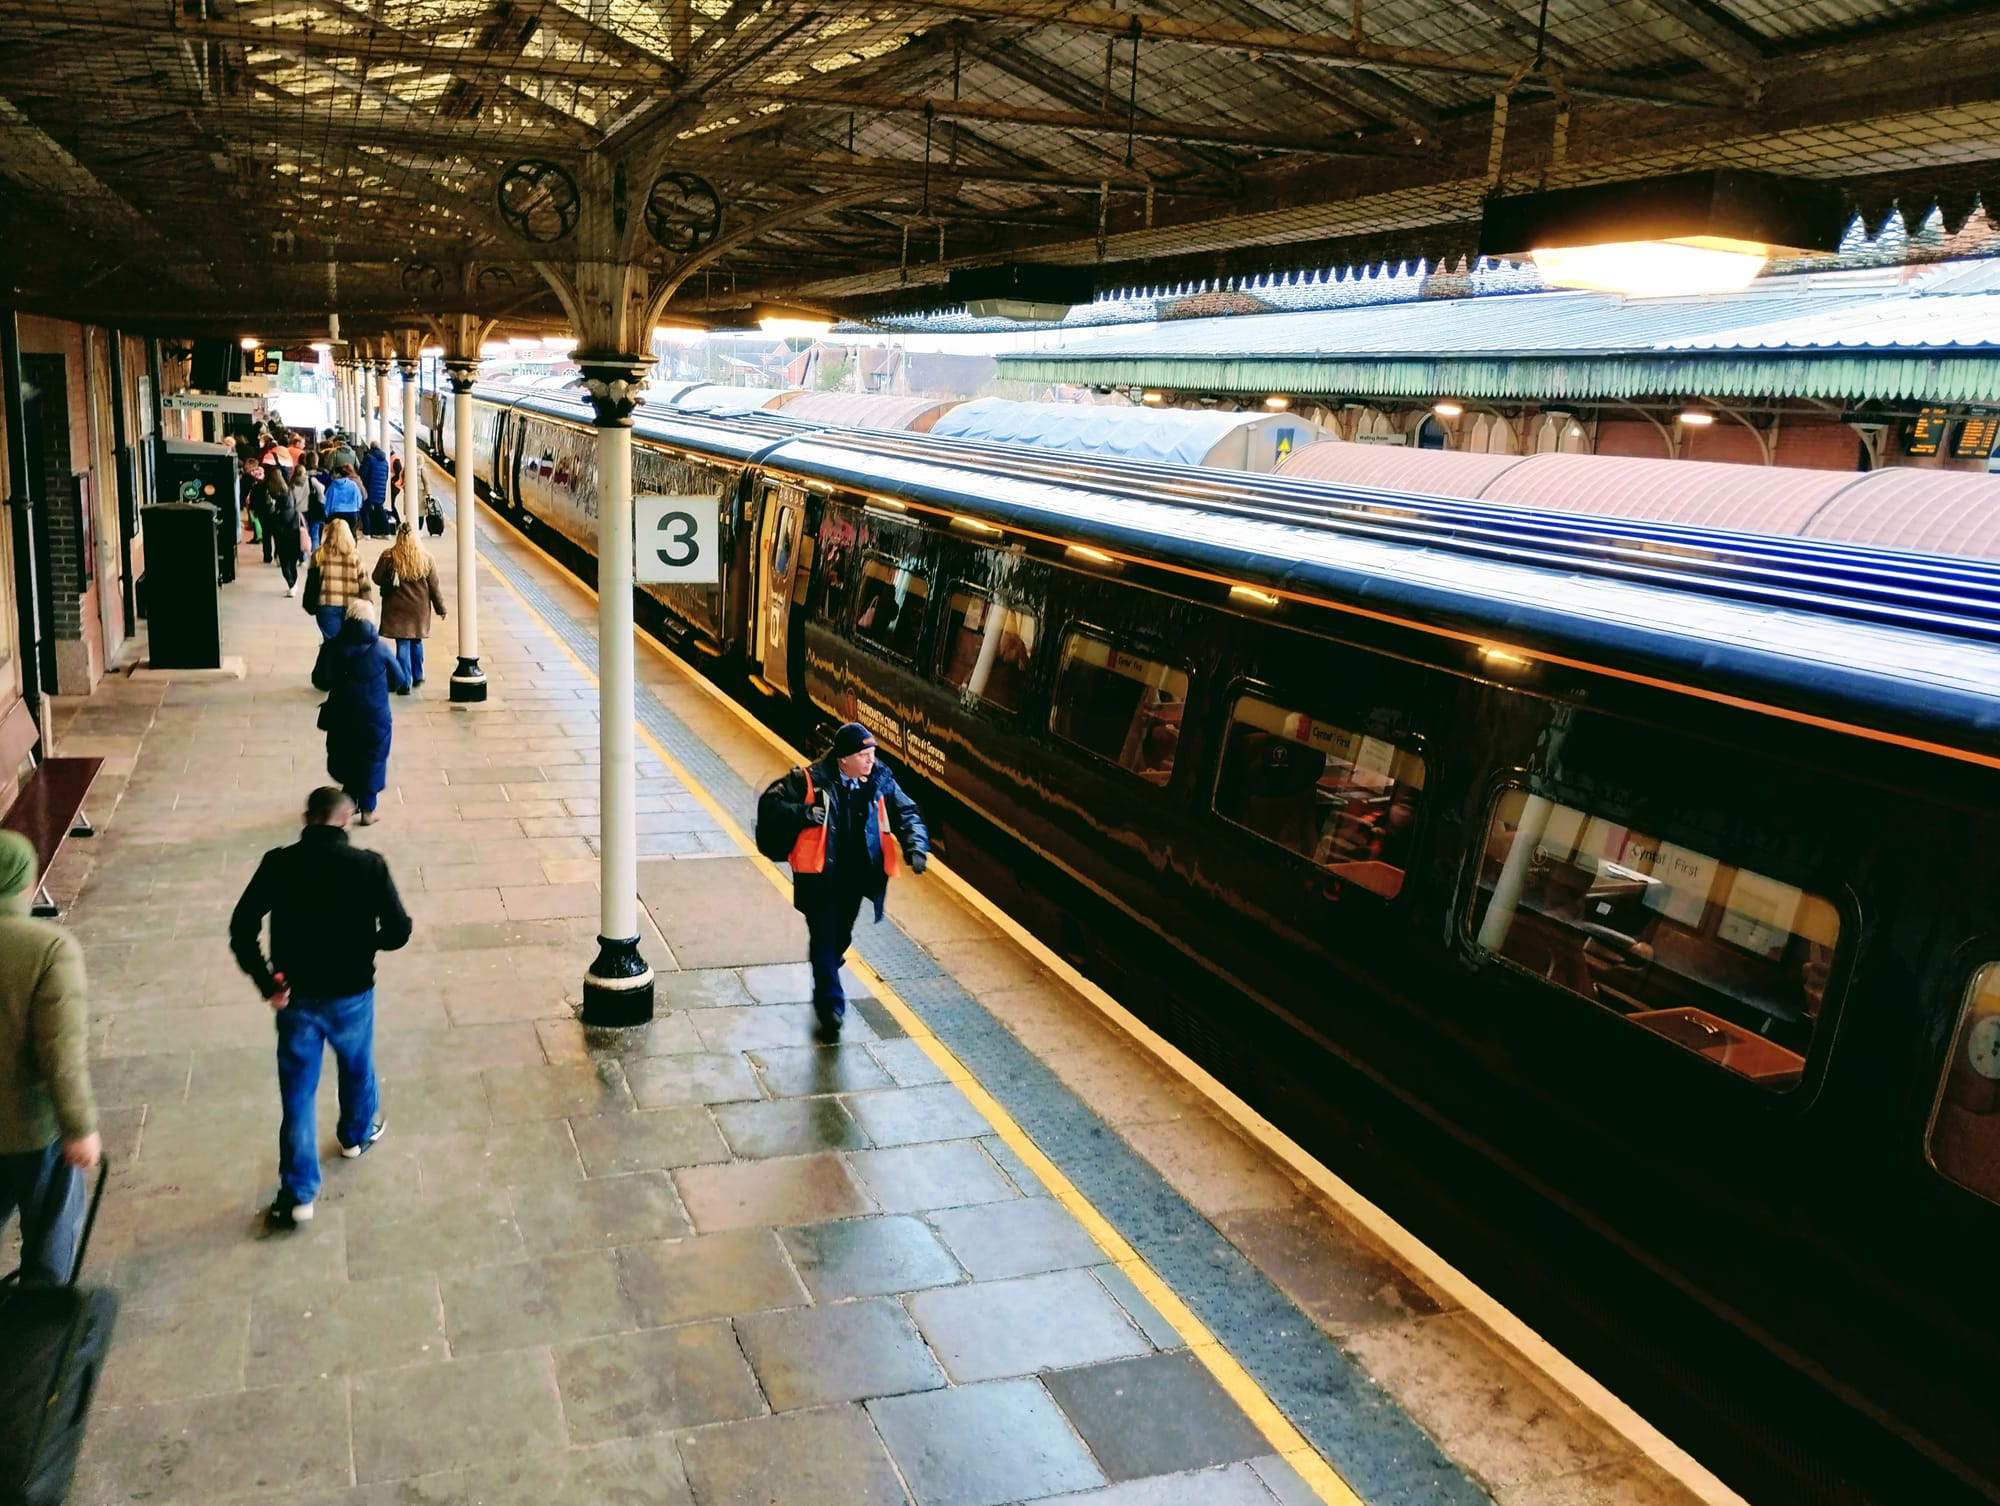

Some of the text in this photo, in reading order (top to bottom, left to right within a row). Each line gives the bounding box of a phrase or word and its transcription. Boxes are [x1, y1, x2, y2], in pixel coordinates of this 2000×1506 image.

[179, 400, 219, 409] Telephone
[656, 511, 700, 567] 3
[857, 710, 902, 748] TRANSPORT FOR WALES
[1632, 844, 1699, 877] Cyntaf First
